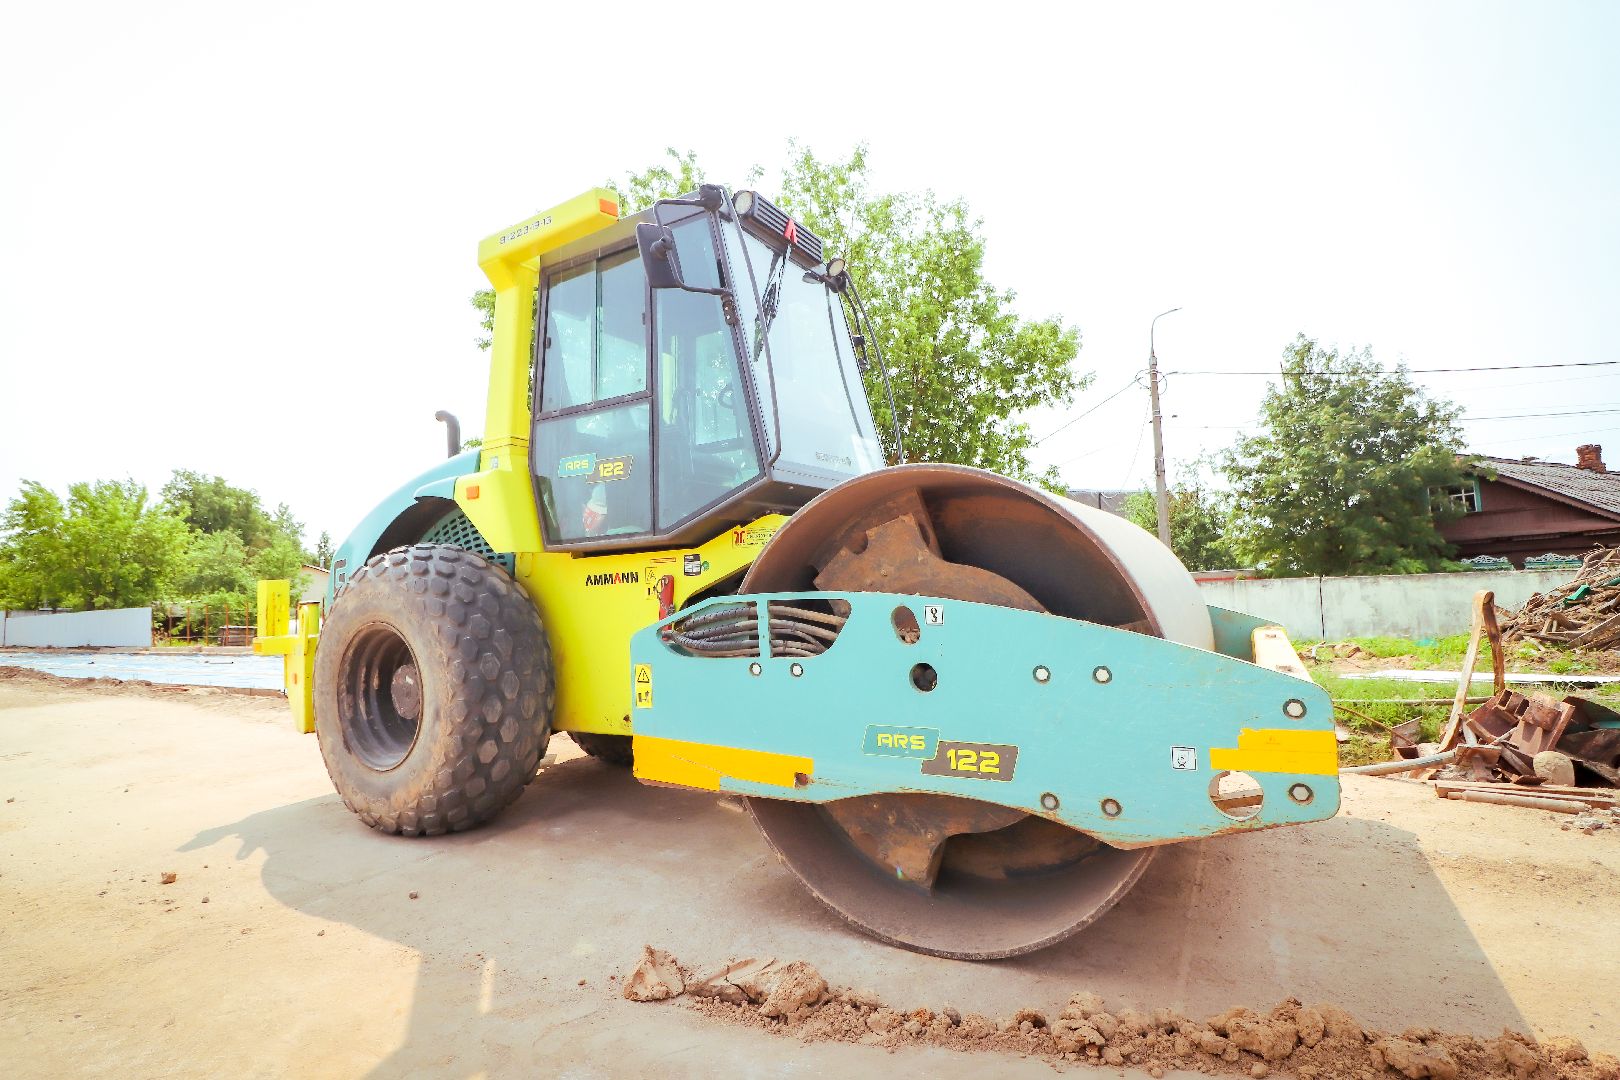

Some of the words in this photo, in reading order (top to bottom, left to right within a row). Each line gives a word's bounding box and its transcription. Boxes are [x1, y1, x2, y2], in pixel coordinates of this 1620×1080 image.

[565, 459, 589, 472] ARS
[599, 461, 624, 477] 122
[585, 571, 639, 587] AMMANN
[877, 733, 925, 750] ARS
[946, 748, 1000, 774] 122
